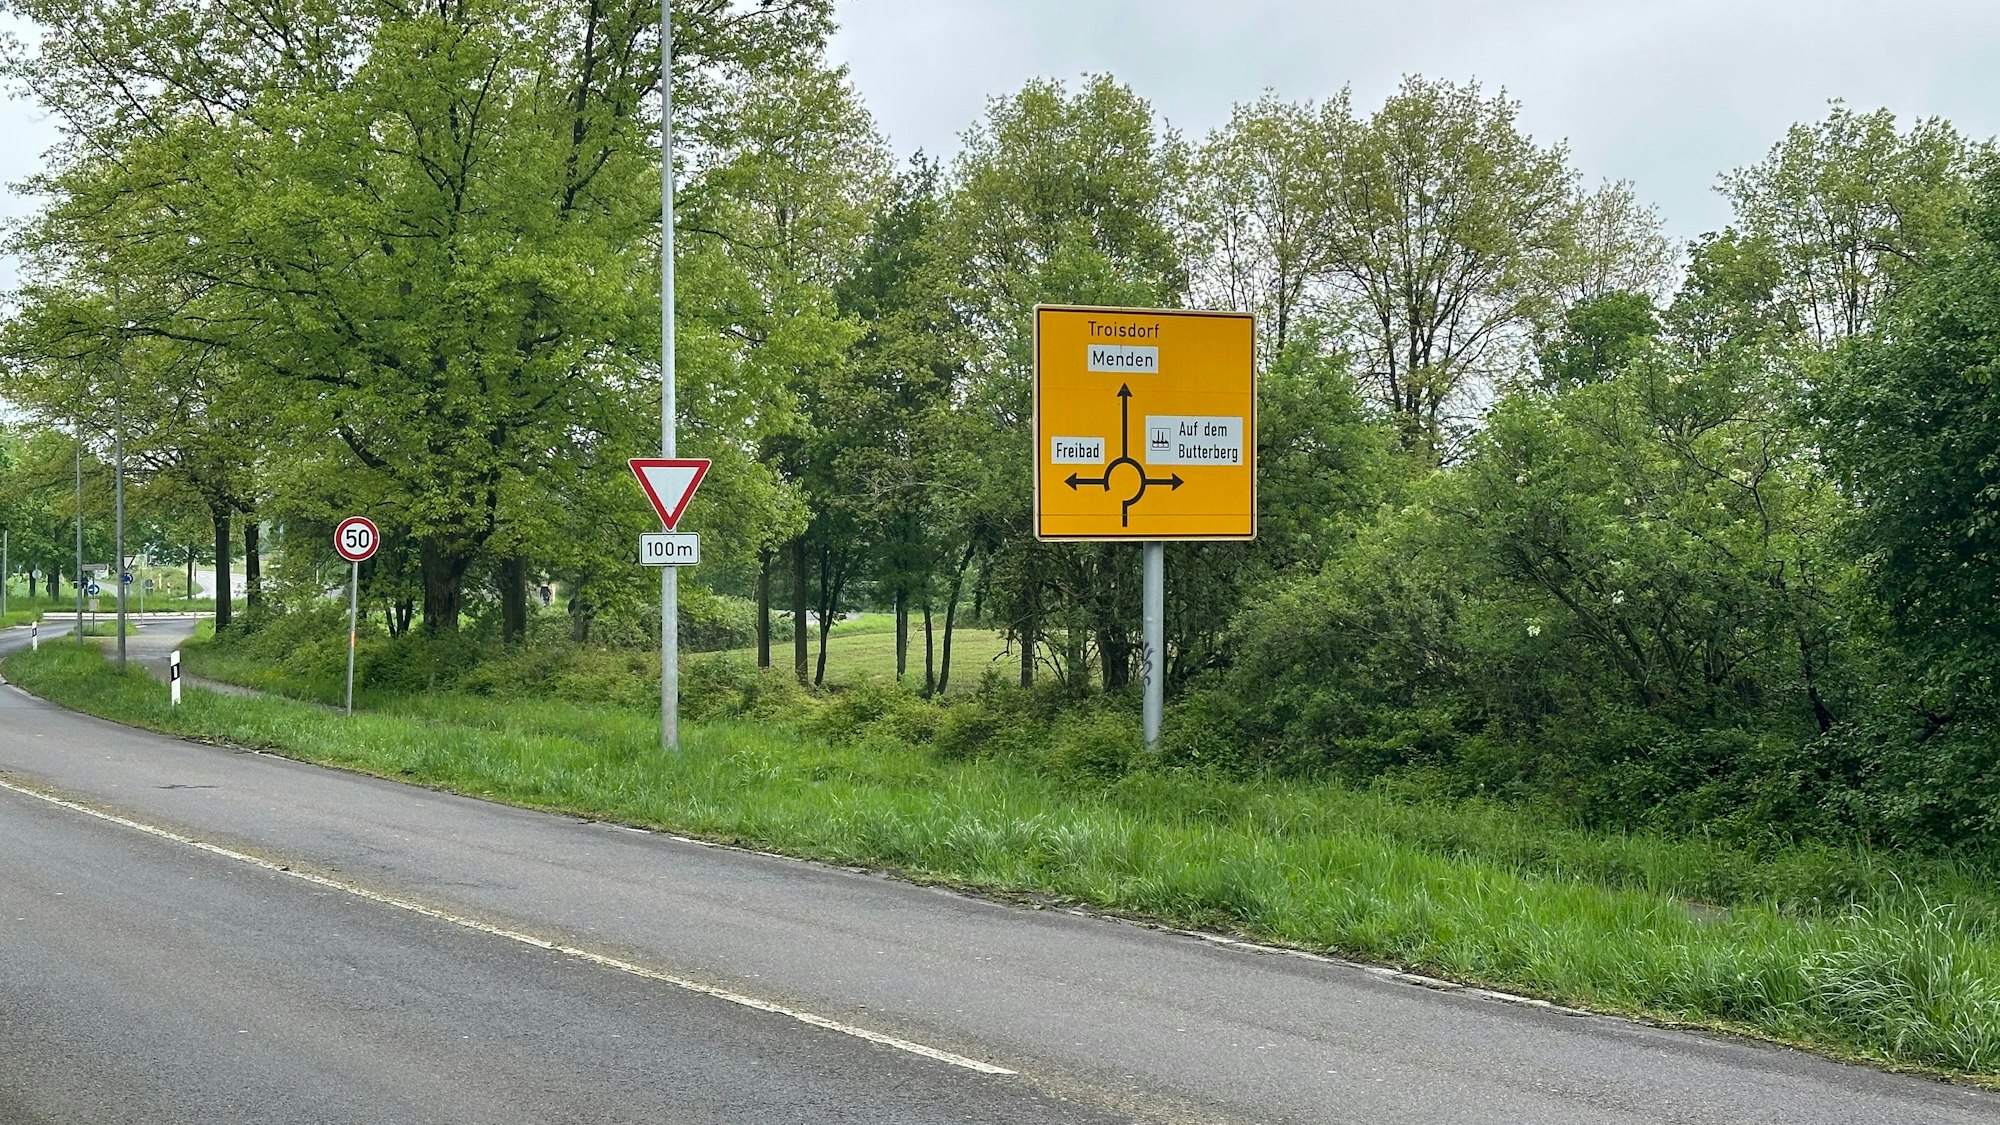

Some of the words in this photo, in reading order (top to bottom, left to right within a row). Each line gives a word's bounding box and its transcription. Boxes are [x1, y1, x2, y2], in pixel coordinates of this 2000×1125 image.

[1088, 321, 1159, 339] Troisdorf
[1092, 350, 1153, 367] Menden
[1179, 421, 1198, 437] Auf
[1204, 422, 1228, 437] dem
[1056, 443, 1100, 458] Freibad
[1178, 444, 1238, 462] Butterberg
[346, 529, 370, 548] 50
